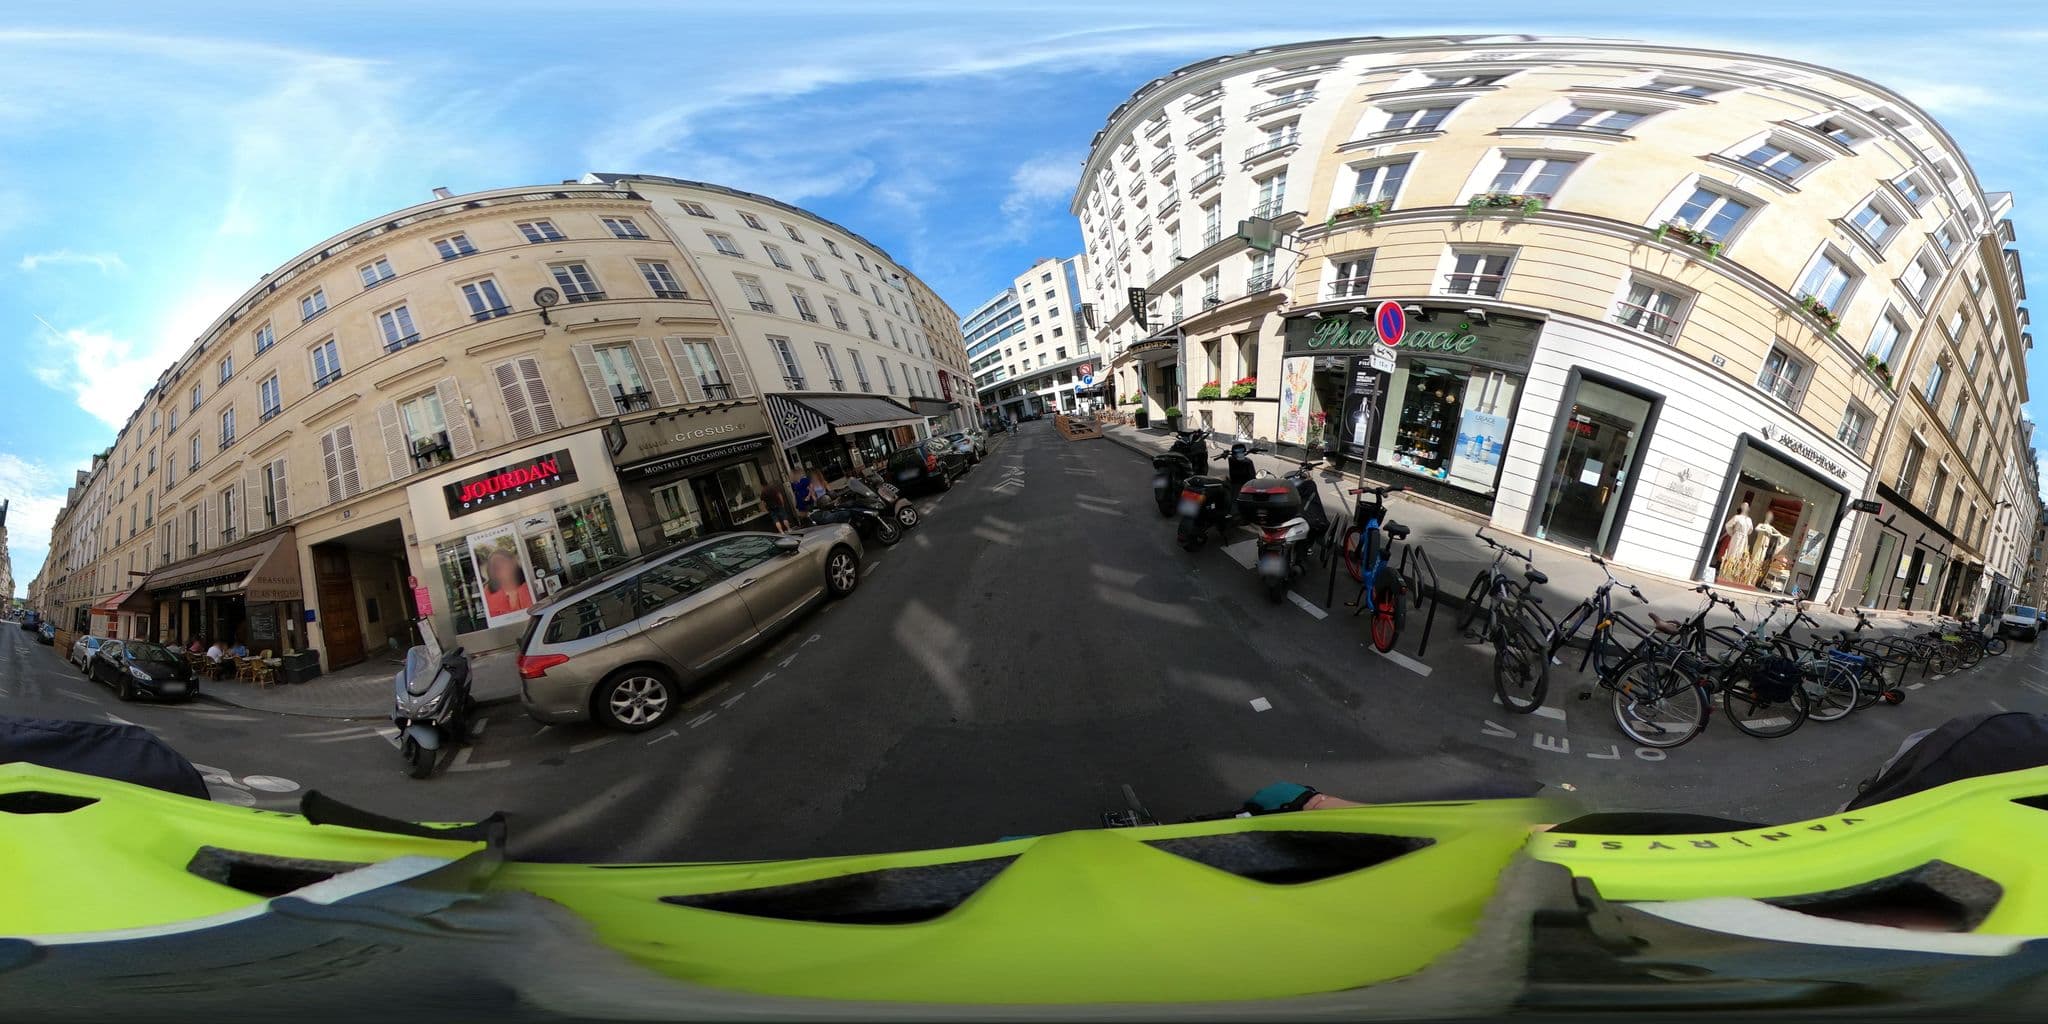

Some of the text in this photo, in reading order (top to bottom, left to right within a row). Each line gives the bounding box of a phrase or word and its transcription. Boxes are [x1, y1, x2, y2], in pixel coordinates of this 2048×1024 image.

[1307, 317, 1478, 353] Pharacie
[459, 457, 559, 502] JOURDAN
[644, 460, 680, 475] MONTRES
[690, 449, 728, 464] OCCASIONS
[463, 475, 560, 509] OPTICIEN
